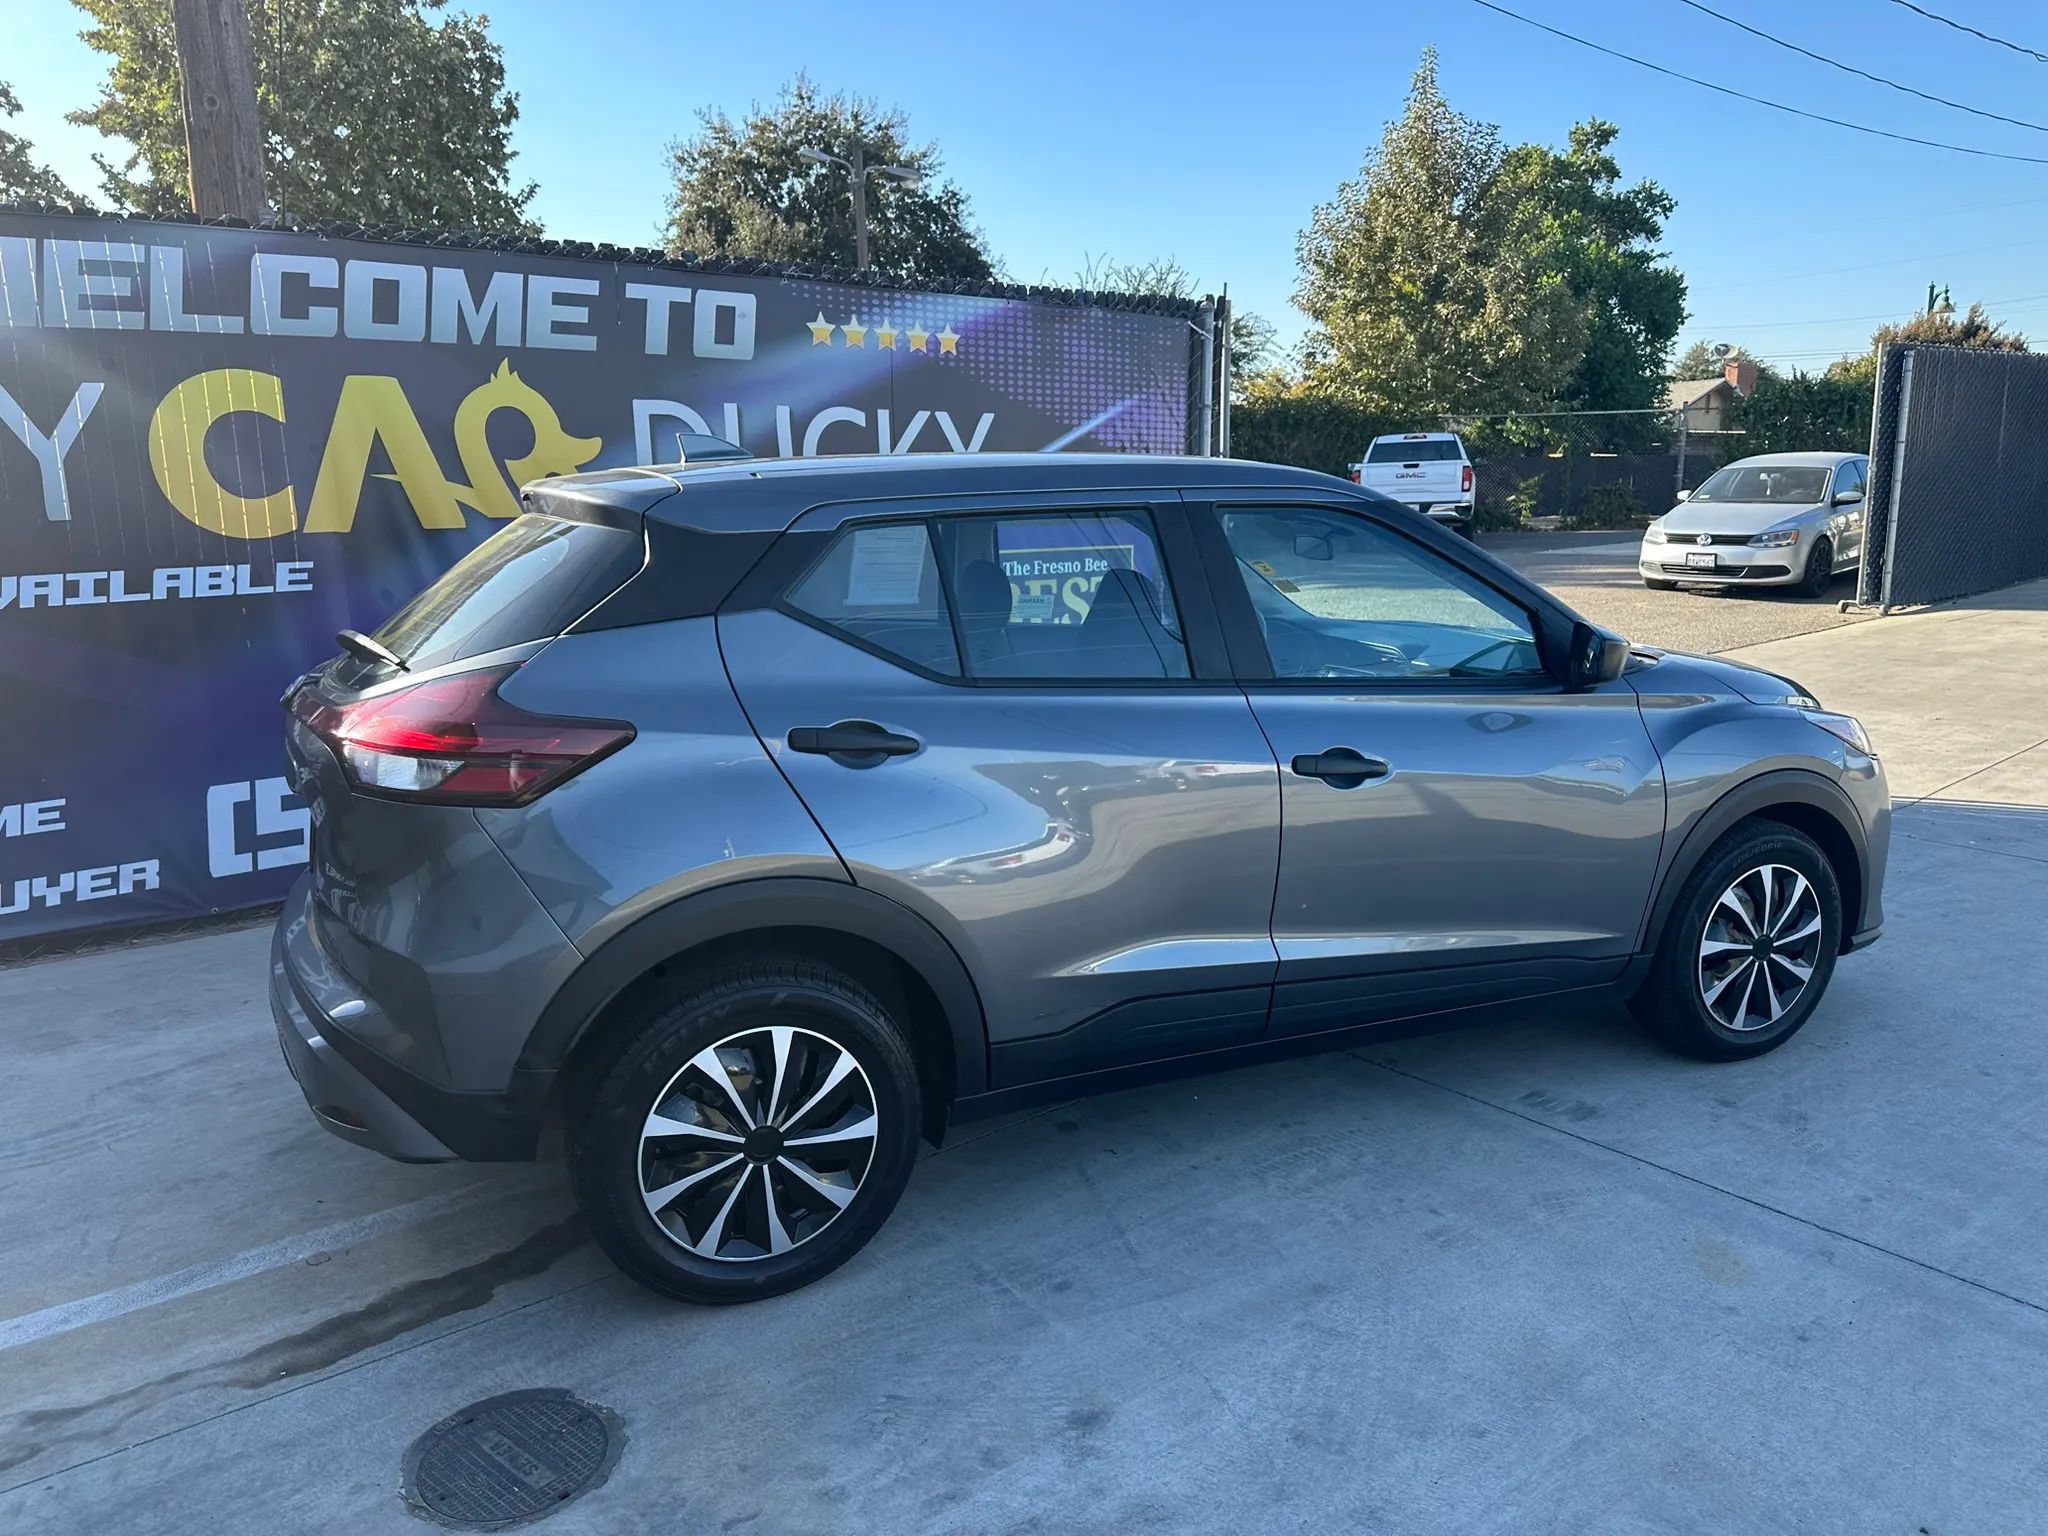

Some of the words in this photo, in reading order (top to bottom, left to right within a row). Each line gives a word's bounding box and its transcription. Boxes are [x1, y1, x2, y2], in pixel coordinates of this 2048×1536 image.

[624, 282, 757, 361] TO
[148, 357, 603, 541] CAR
[1003, 560, 1031, 577] The
[1033, 559, 1081, 576] Fresno
[1084, 557, 1108, 572] Bee
